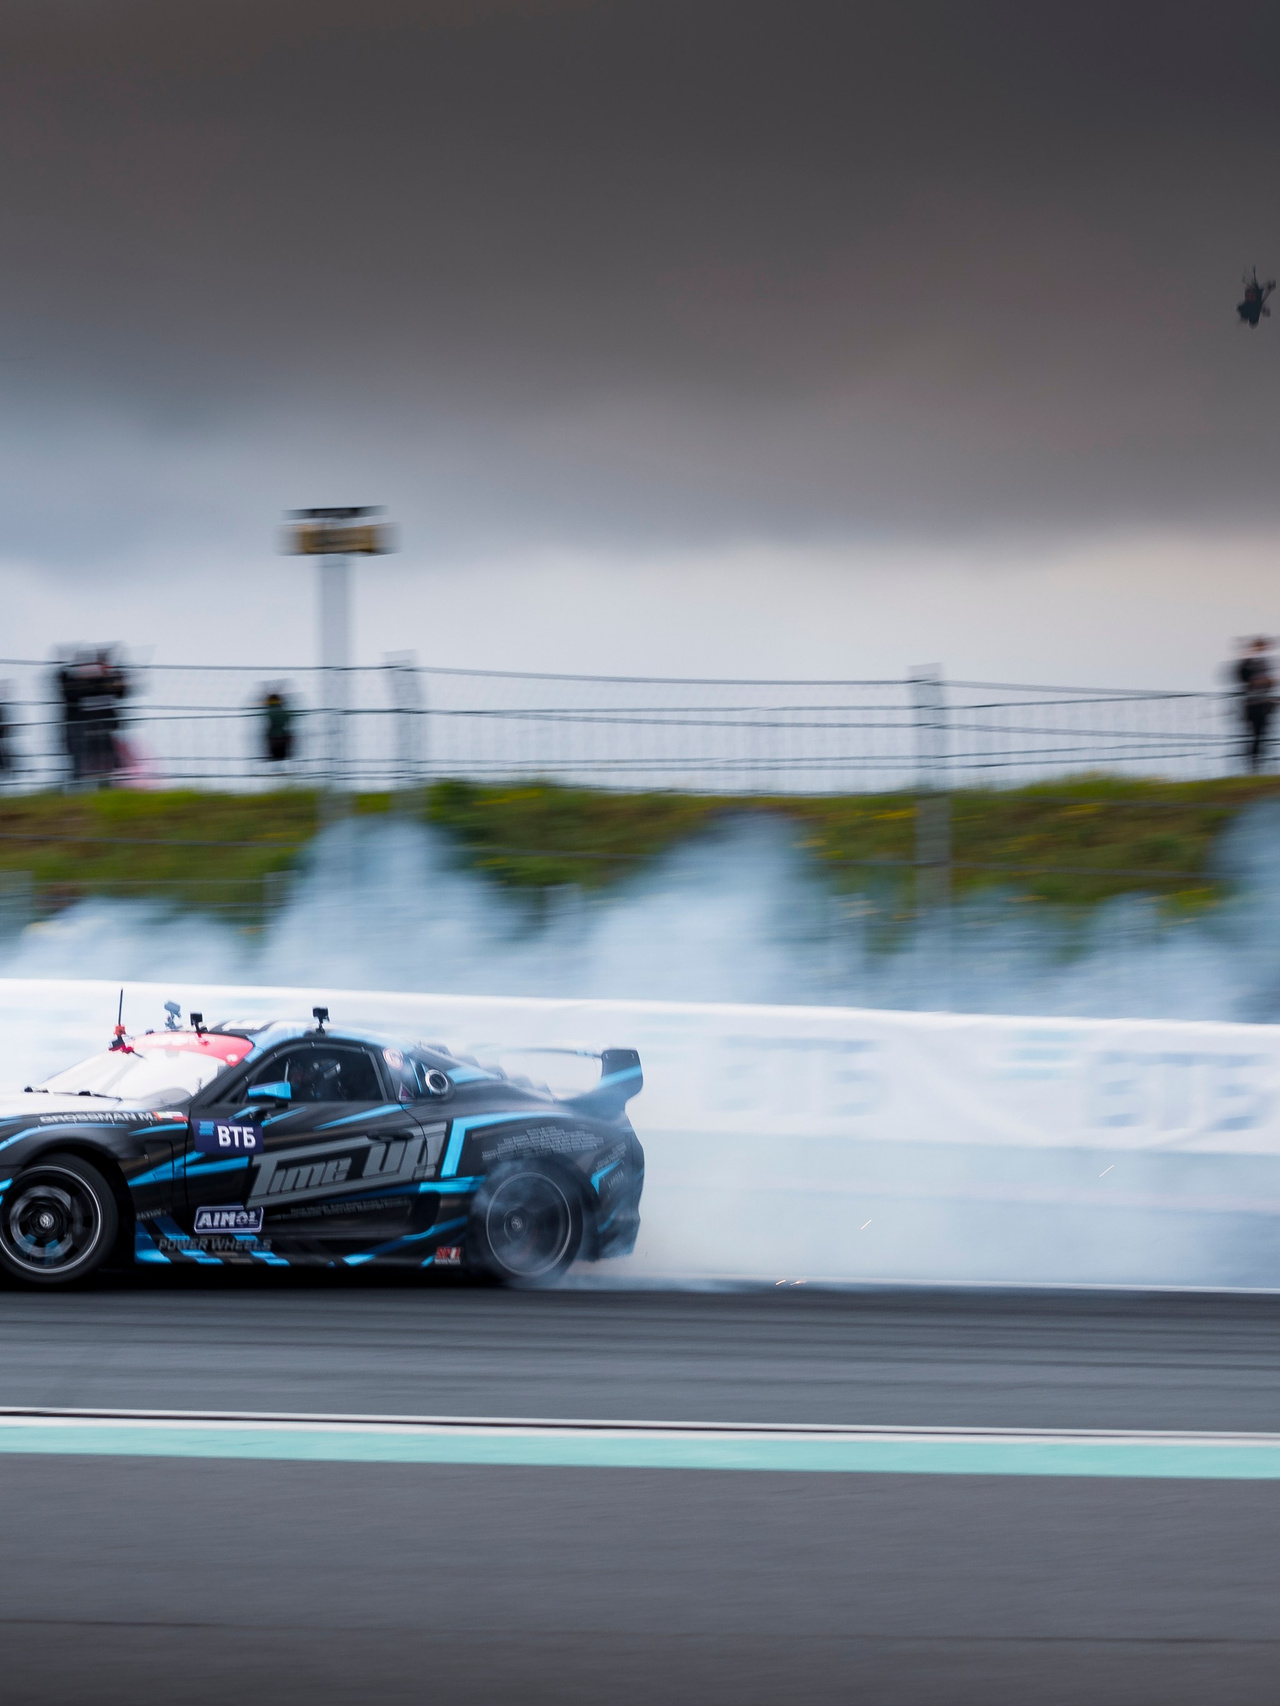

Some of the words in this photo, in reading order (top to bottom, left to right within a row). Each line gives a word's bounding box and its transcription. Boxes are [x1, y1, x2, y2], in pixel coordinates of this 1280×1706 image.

[40, 1112, 137, 1123] GROSSMAN
[217, 1125, 256, 1148] ВТБ
[197, 1211, 259, 1228] AIMOL
[158, 1238, 209, 1251] POWER
[211, 1237, 272, 1251] WHEELS
